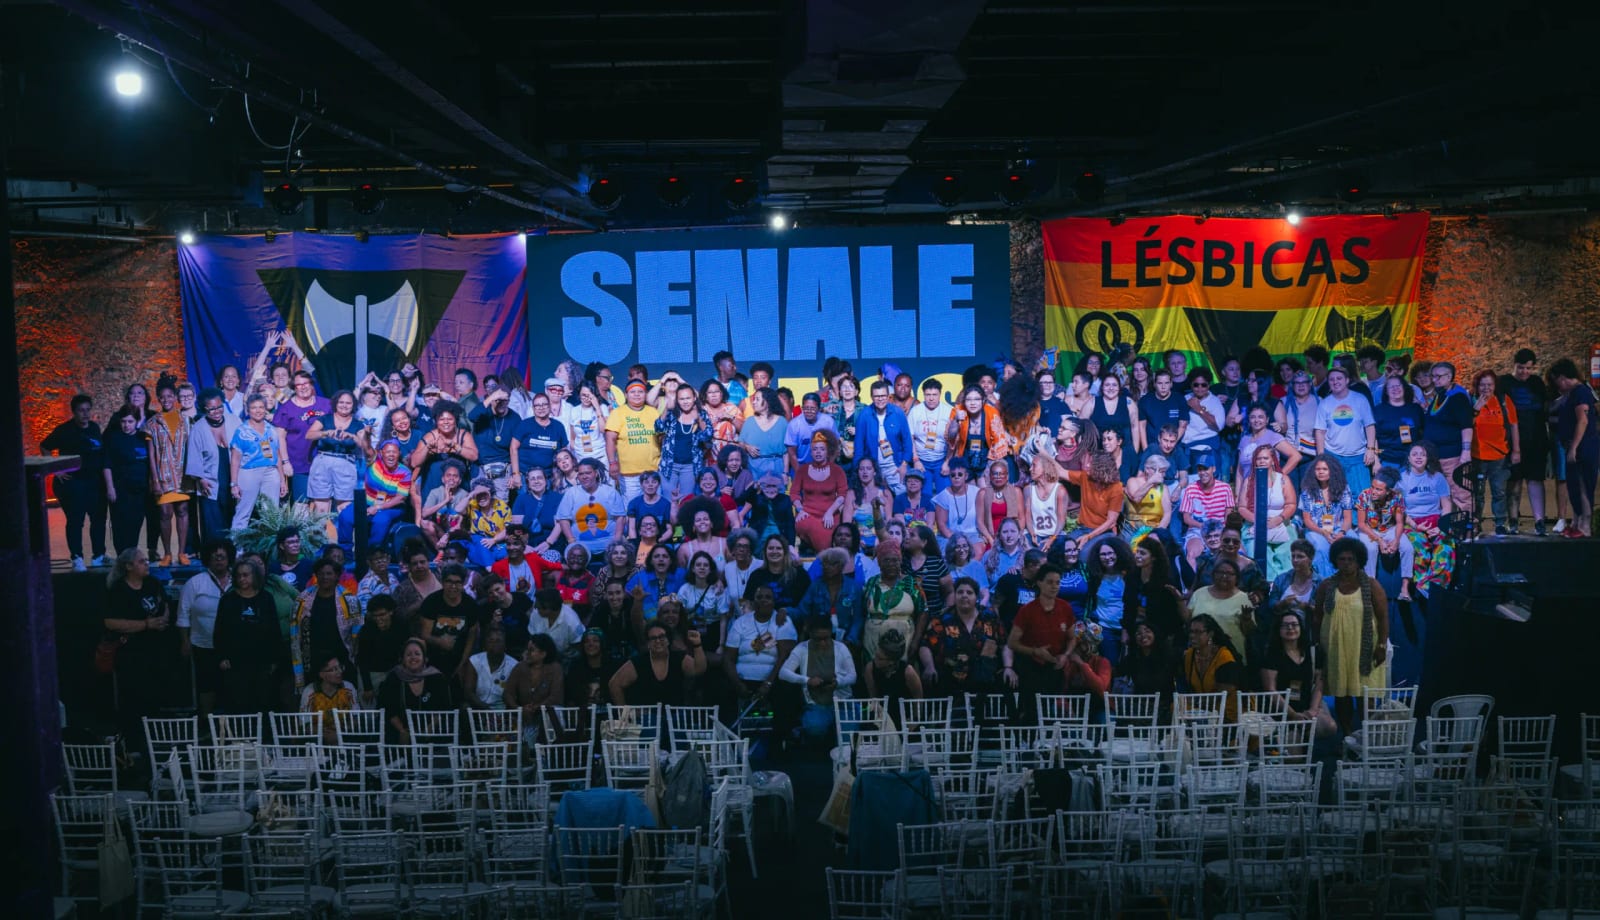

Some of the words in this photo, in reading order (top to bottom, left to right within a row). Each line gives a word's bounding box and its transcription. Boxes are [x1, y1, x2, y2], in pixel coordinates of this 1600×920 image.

[1101, 225, 1371, 288] LÉSBICAS
[560, 243, 976, 366] SENALE
[1036, 516, 1053, 530] 23
